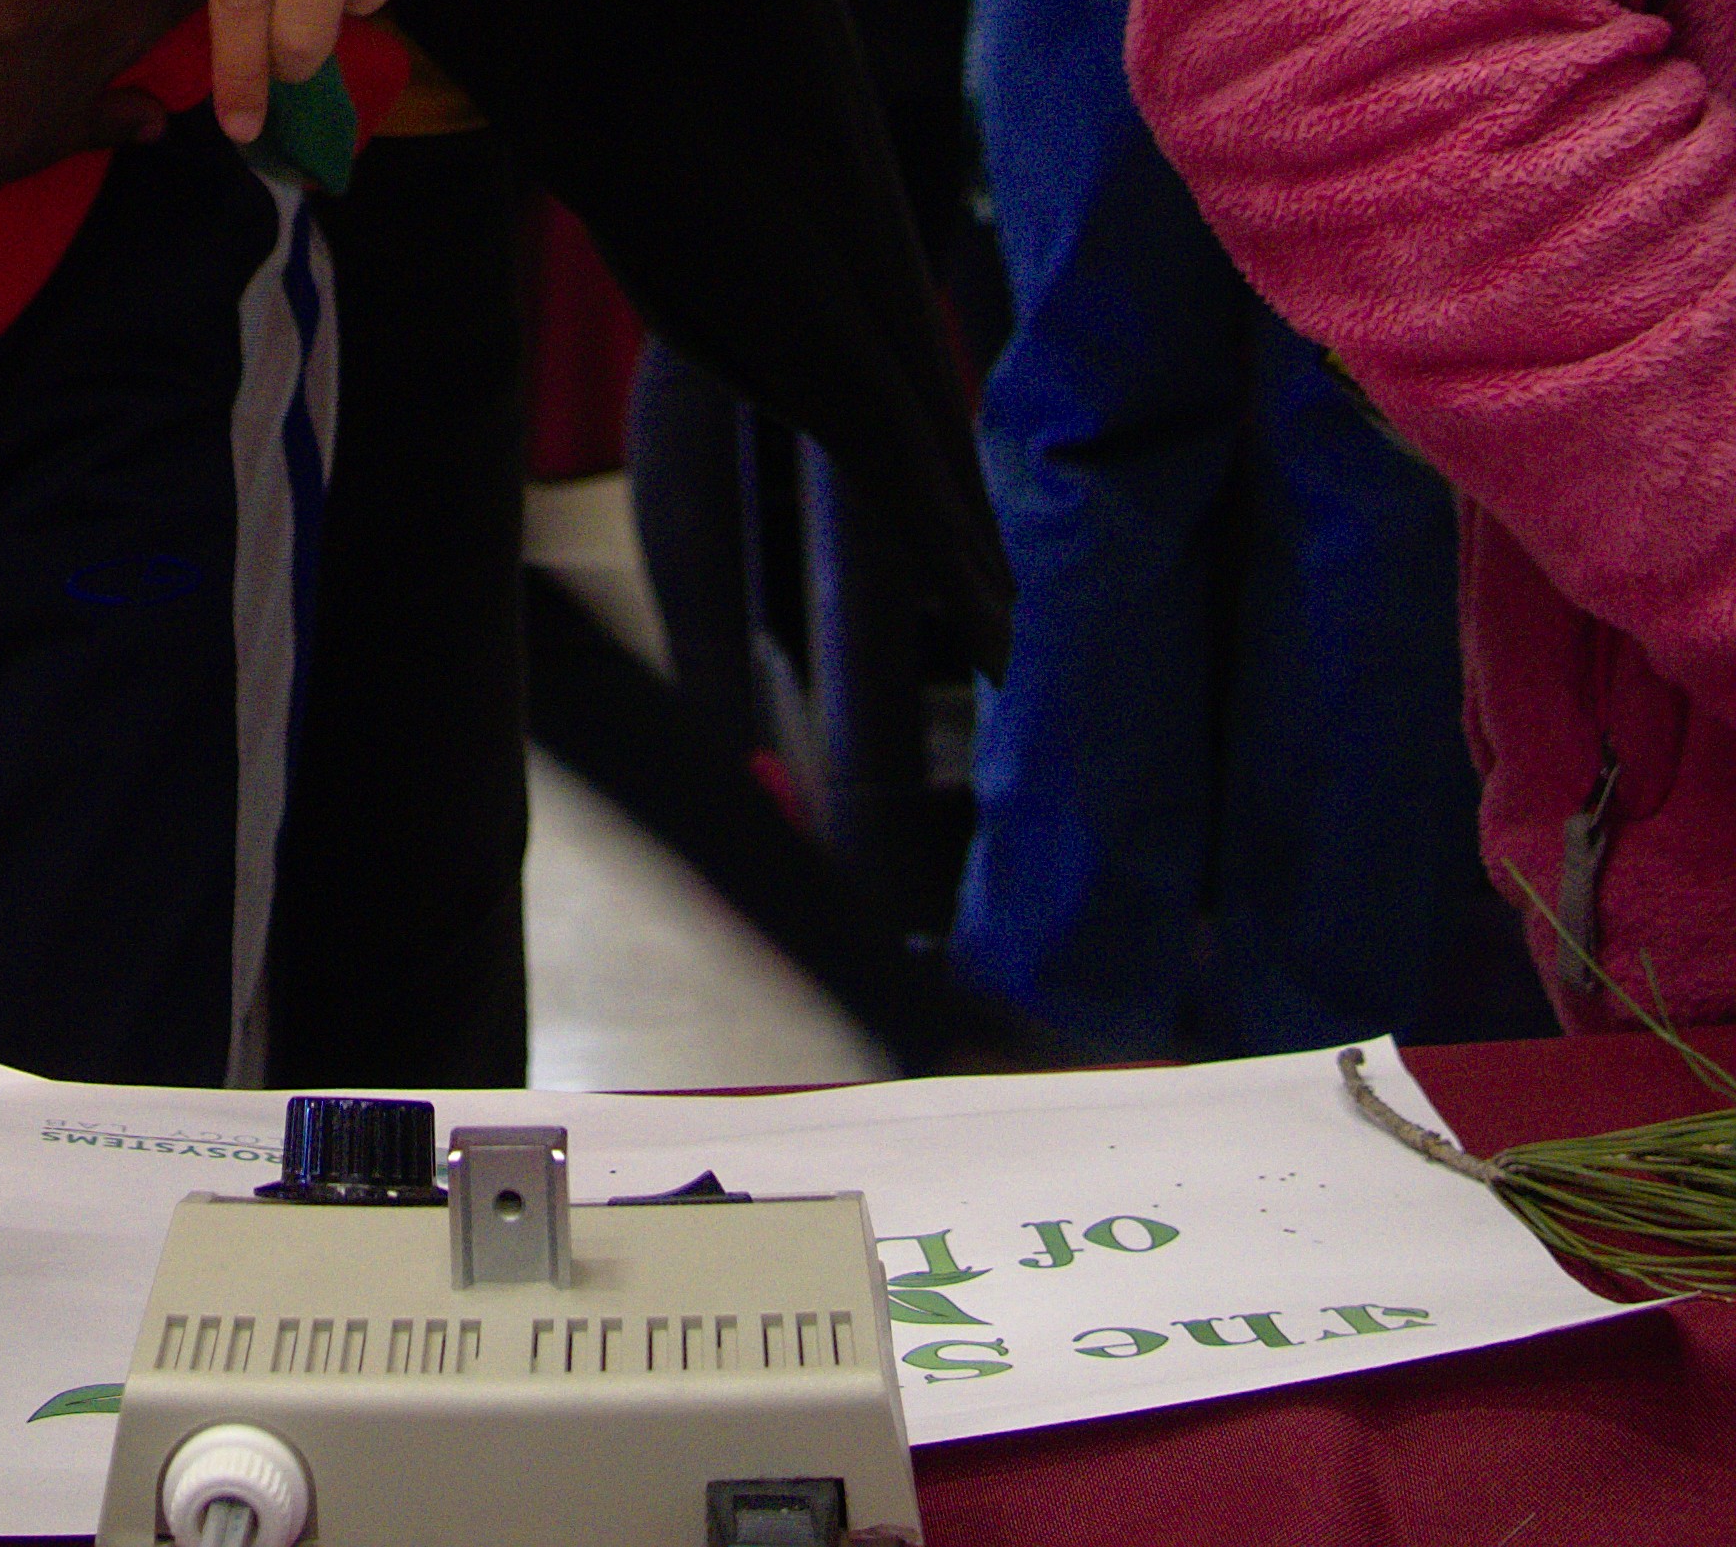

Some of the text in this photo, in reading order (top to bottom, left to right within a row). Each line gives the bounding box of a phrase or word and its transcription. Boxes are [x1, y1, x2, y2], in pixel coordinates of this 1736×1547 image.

[1019, 1215, 1180, 1269] of
[900, 1303, 1437, 1384] The S
